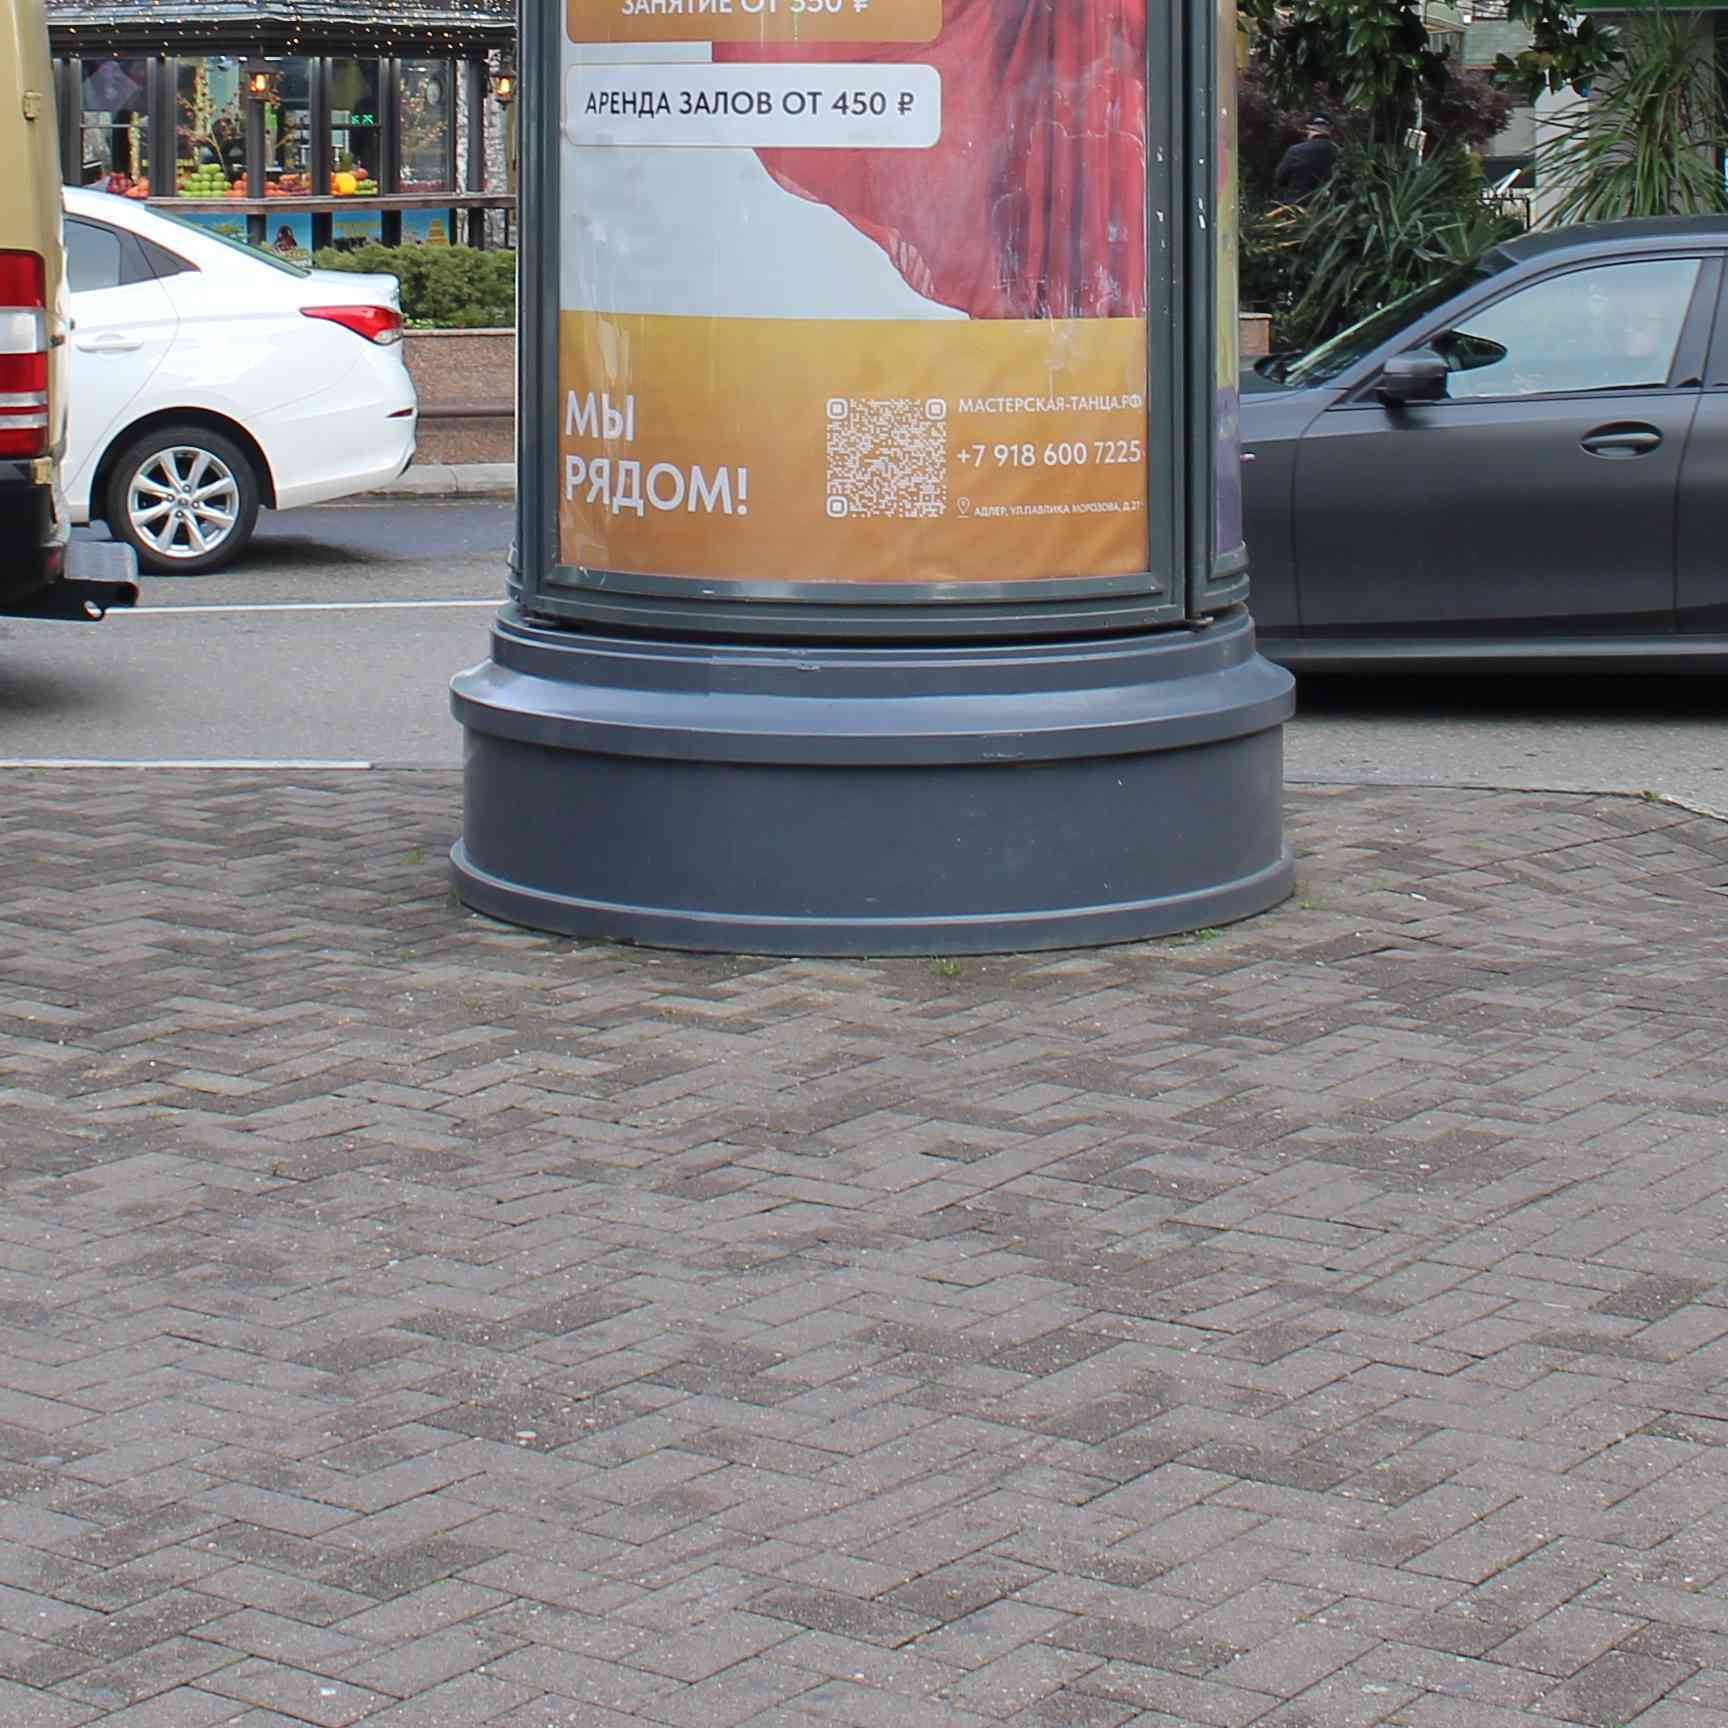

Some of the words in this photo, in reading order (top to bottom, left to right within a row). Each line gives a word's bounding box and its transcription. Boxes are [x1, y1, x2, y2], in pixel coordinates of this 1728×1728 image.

[584, 90, 671, 119] АРЕНДА
[679, 90, 773, 115] ЗАЛОВ
[782, 90, 823, 115] ОТ
[831, 90, 887, 115] 450
[565, 389, 635, 442] МЫ
[958, 393, 1143, 414] МАСТЕРСКАЯ-ТАНЦА.РФ
[956, 443, 987, 468] +7
[993, 443, 1037, 468] 918
[1043, 441, 1088, 466] 600
[1093, 439, 1142, 464] 7225
[565, 454, 749, 517] РЯДОМ!
